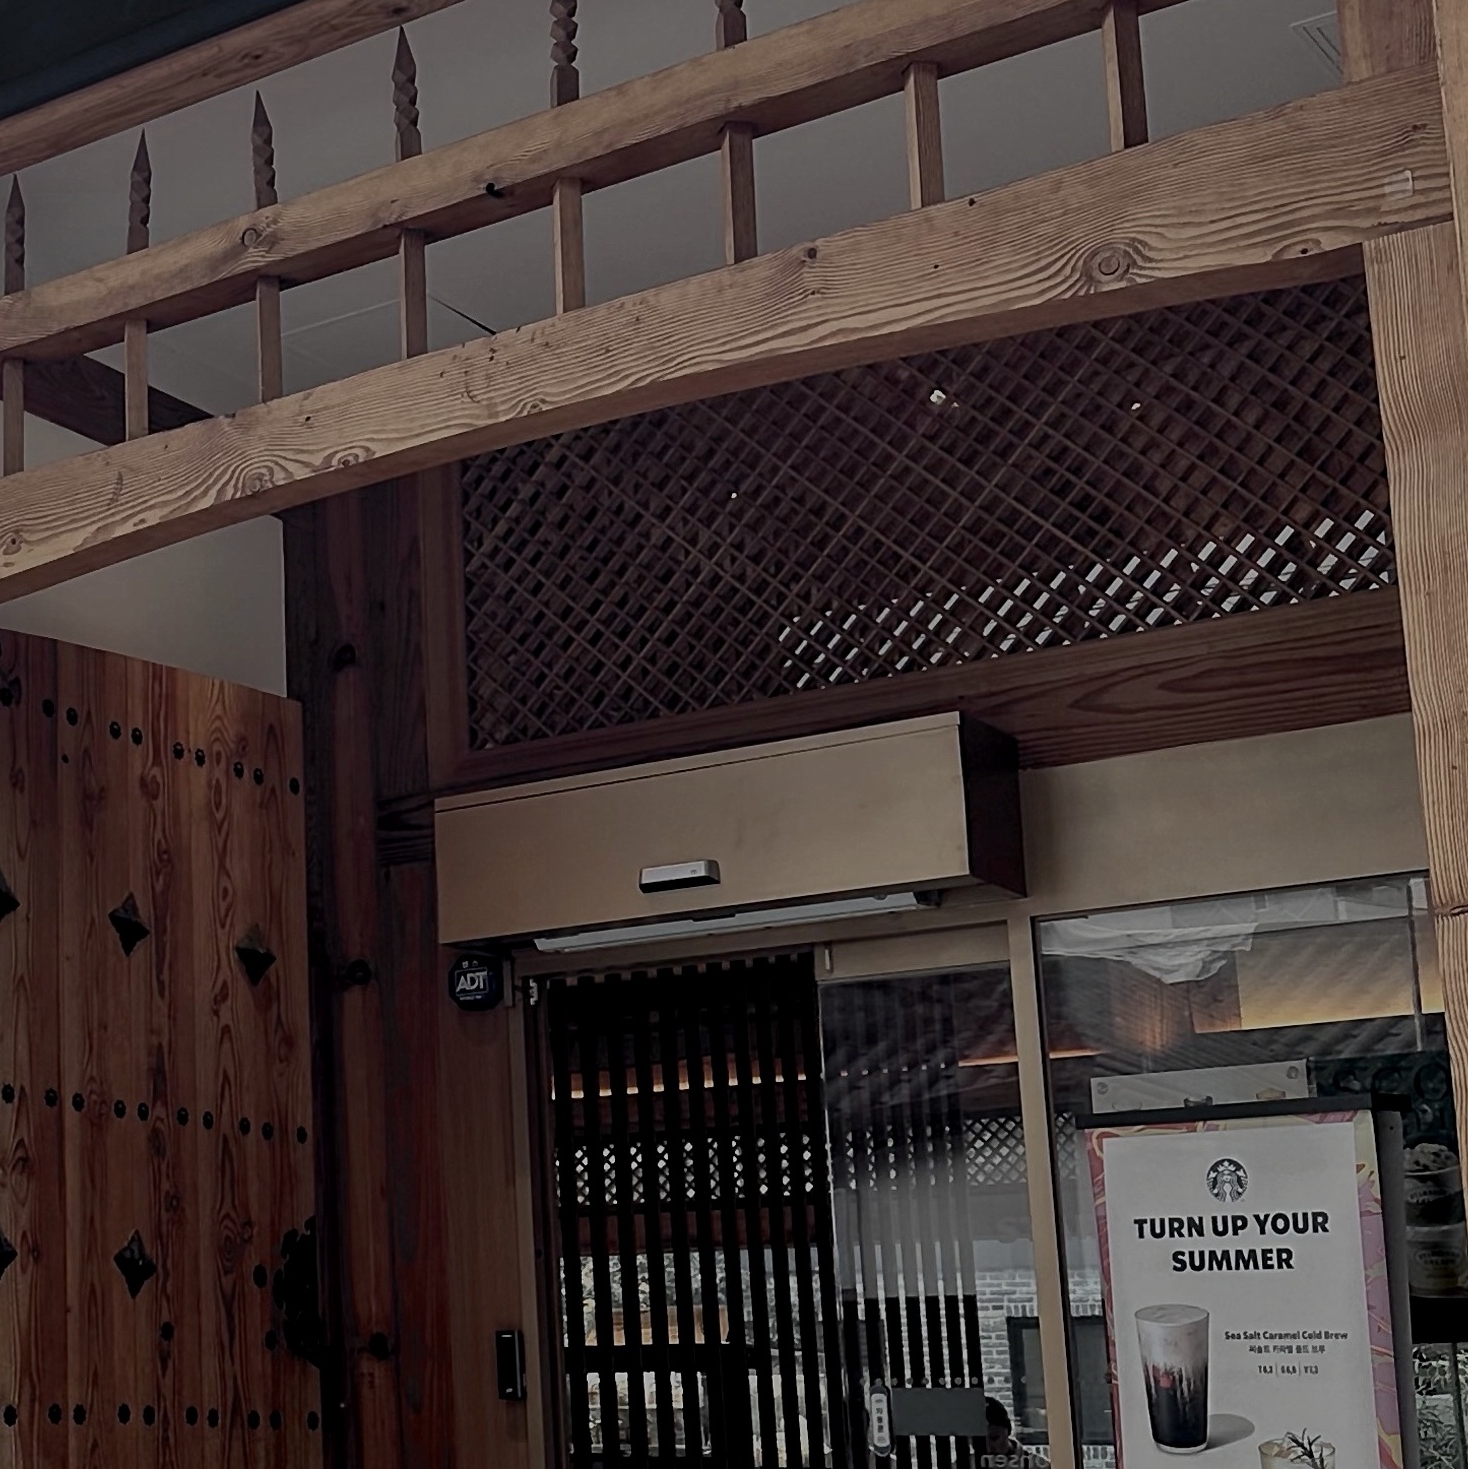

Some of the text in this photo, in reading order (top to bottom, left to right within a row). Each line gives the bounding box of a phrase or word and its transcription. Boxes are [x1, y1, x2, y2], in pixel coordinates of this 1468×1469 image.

[455, 971, 488, 992] ADT
[1133, 1211, 1330, 1239] TURN UP YOUR
[1172, 1247, 1295, 1272] SUMMER
[1225, 1330, 1348, 1340] Sea Salt Caramel Cold Brew
